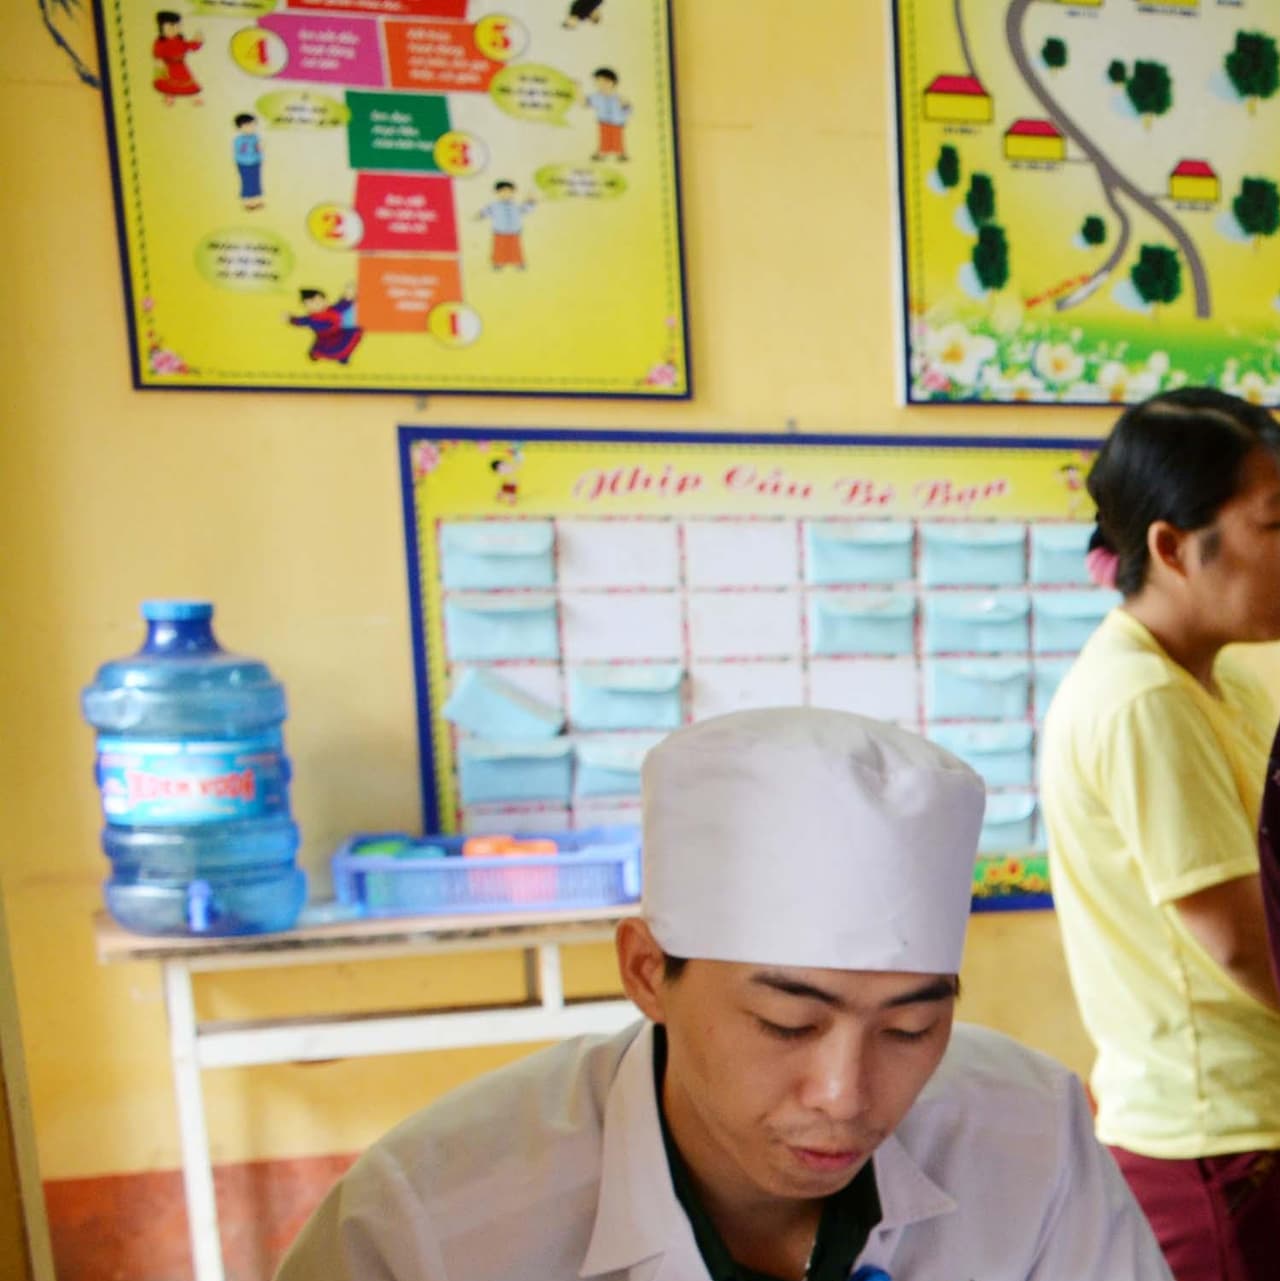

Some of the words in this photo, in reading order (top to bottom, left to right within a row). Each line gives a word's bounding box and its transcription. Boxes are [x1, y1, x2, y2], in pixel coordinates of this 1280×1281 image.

[490, 23, 512, 51] 5
[448, 141, 471, 168] 3
[321, 211, 344, 239] 2
